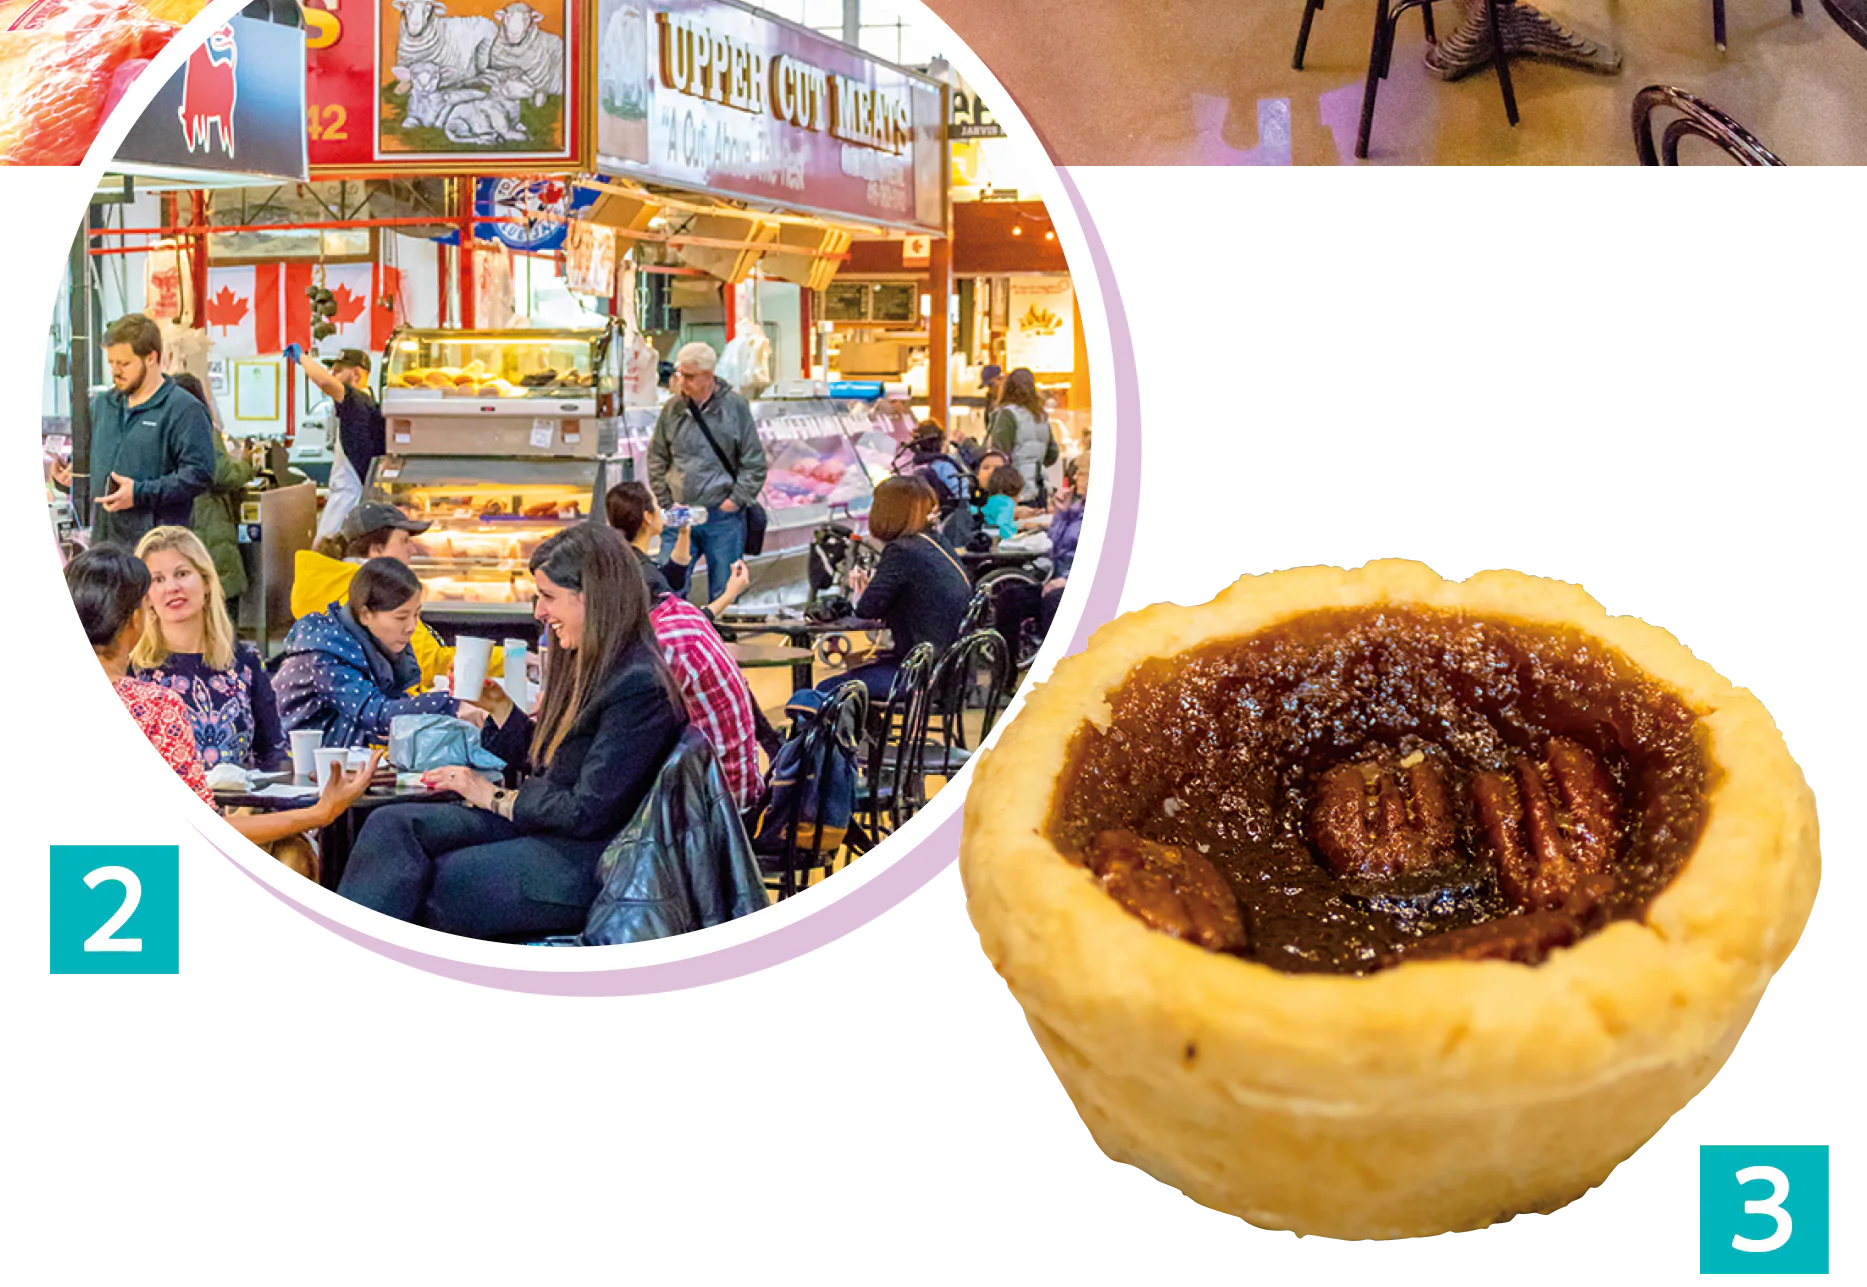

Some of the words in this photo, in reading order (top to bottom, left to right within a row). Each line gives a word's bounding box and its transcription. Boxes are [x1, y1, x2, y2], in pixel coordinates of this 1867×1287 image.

[656, 11, 768, 115] UPPER
[769, 54, 827, 133] CUT
[827, 74, 913, 156] MEATS
